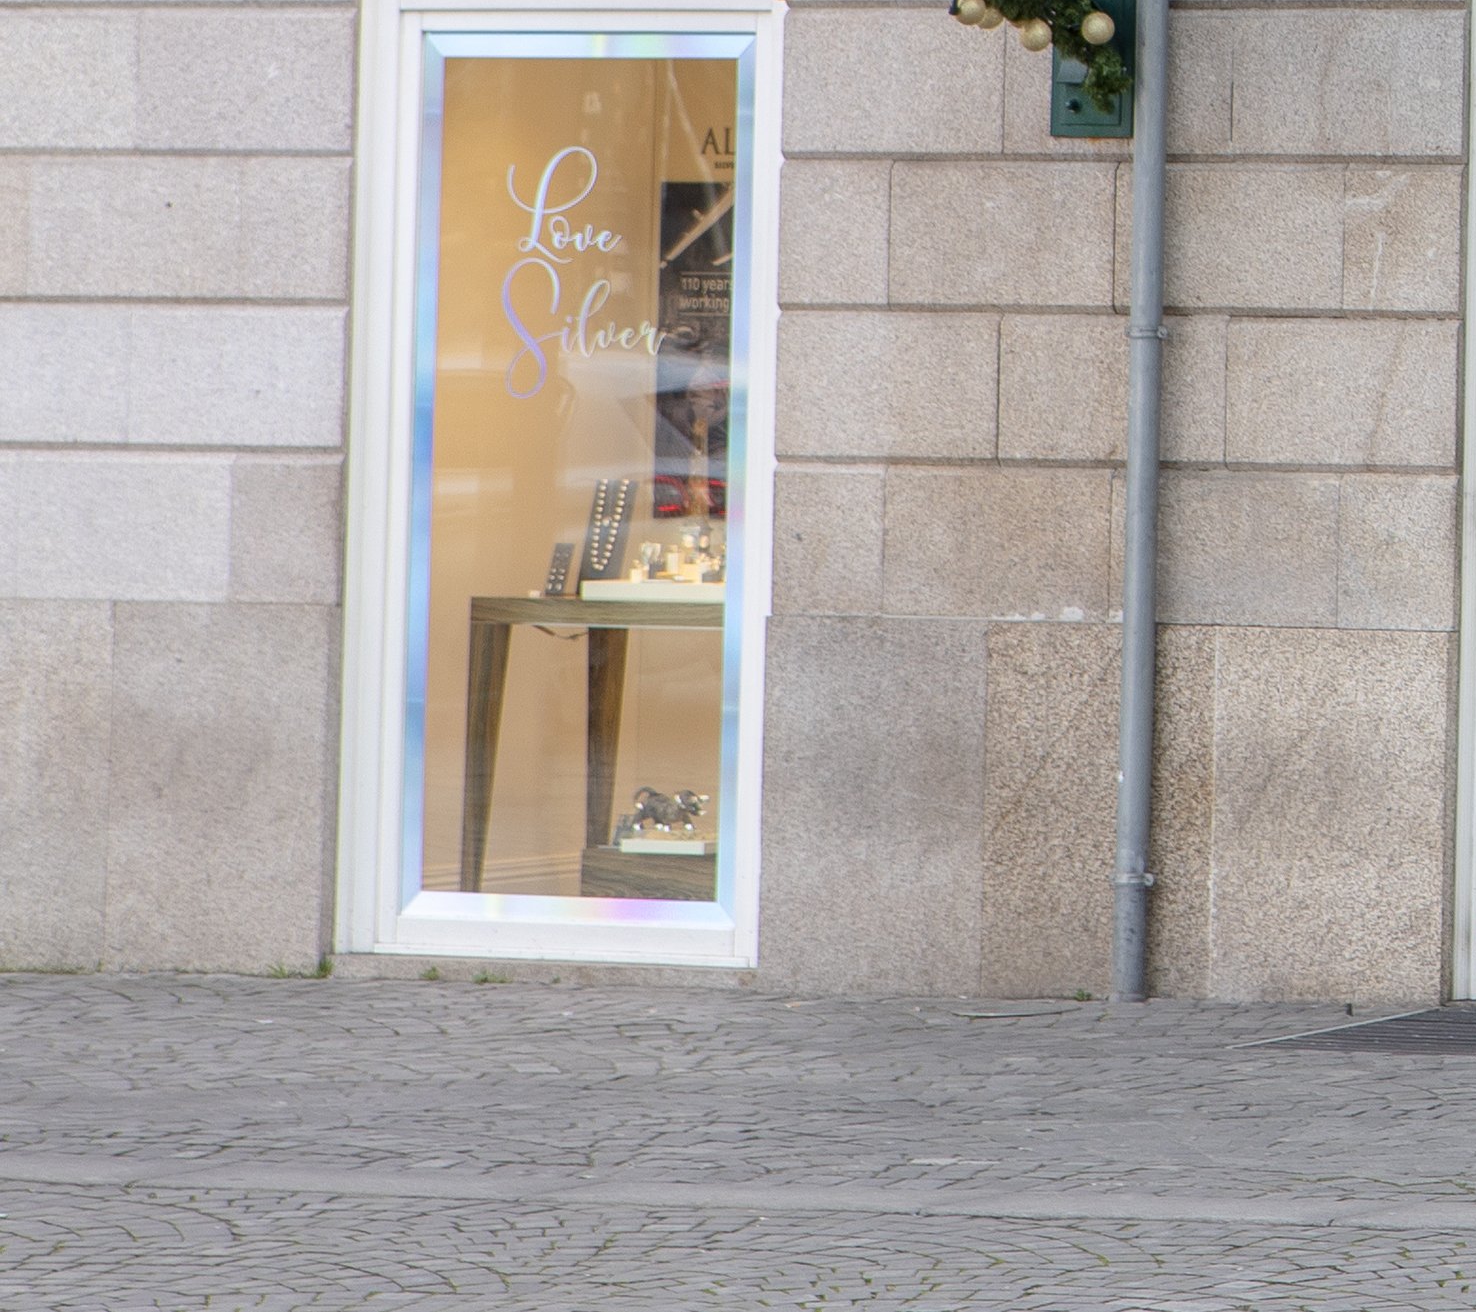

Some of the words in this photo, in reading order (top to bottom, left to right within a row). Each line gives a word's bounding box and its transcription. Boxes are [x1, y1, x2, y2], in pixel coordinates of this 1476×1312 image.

[506, 145, 623, 264] Love
[501, 257, 668, 399] Silver
[679, 294, 731, 313] working
